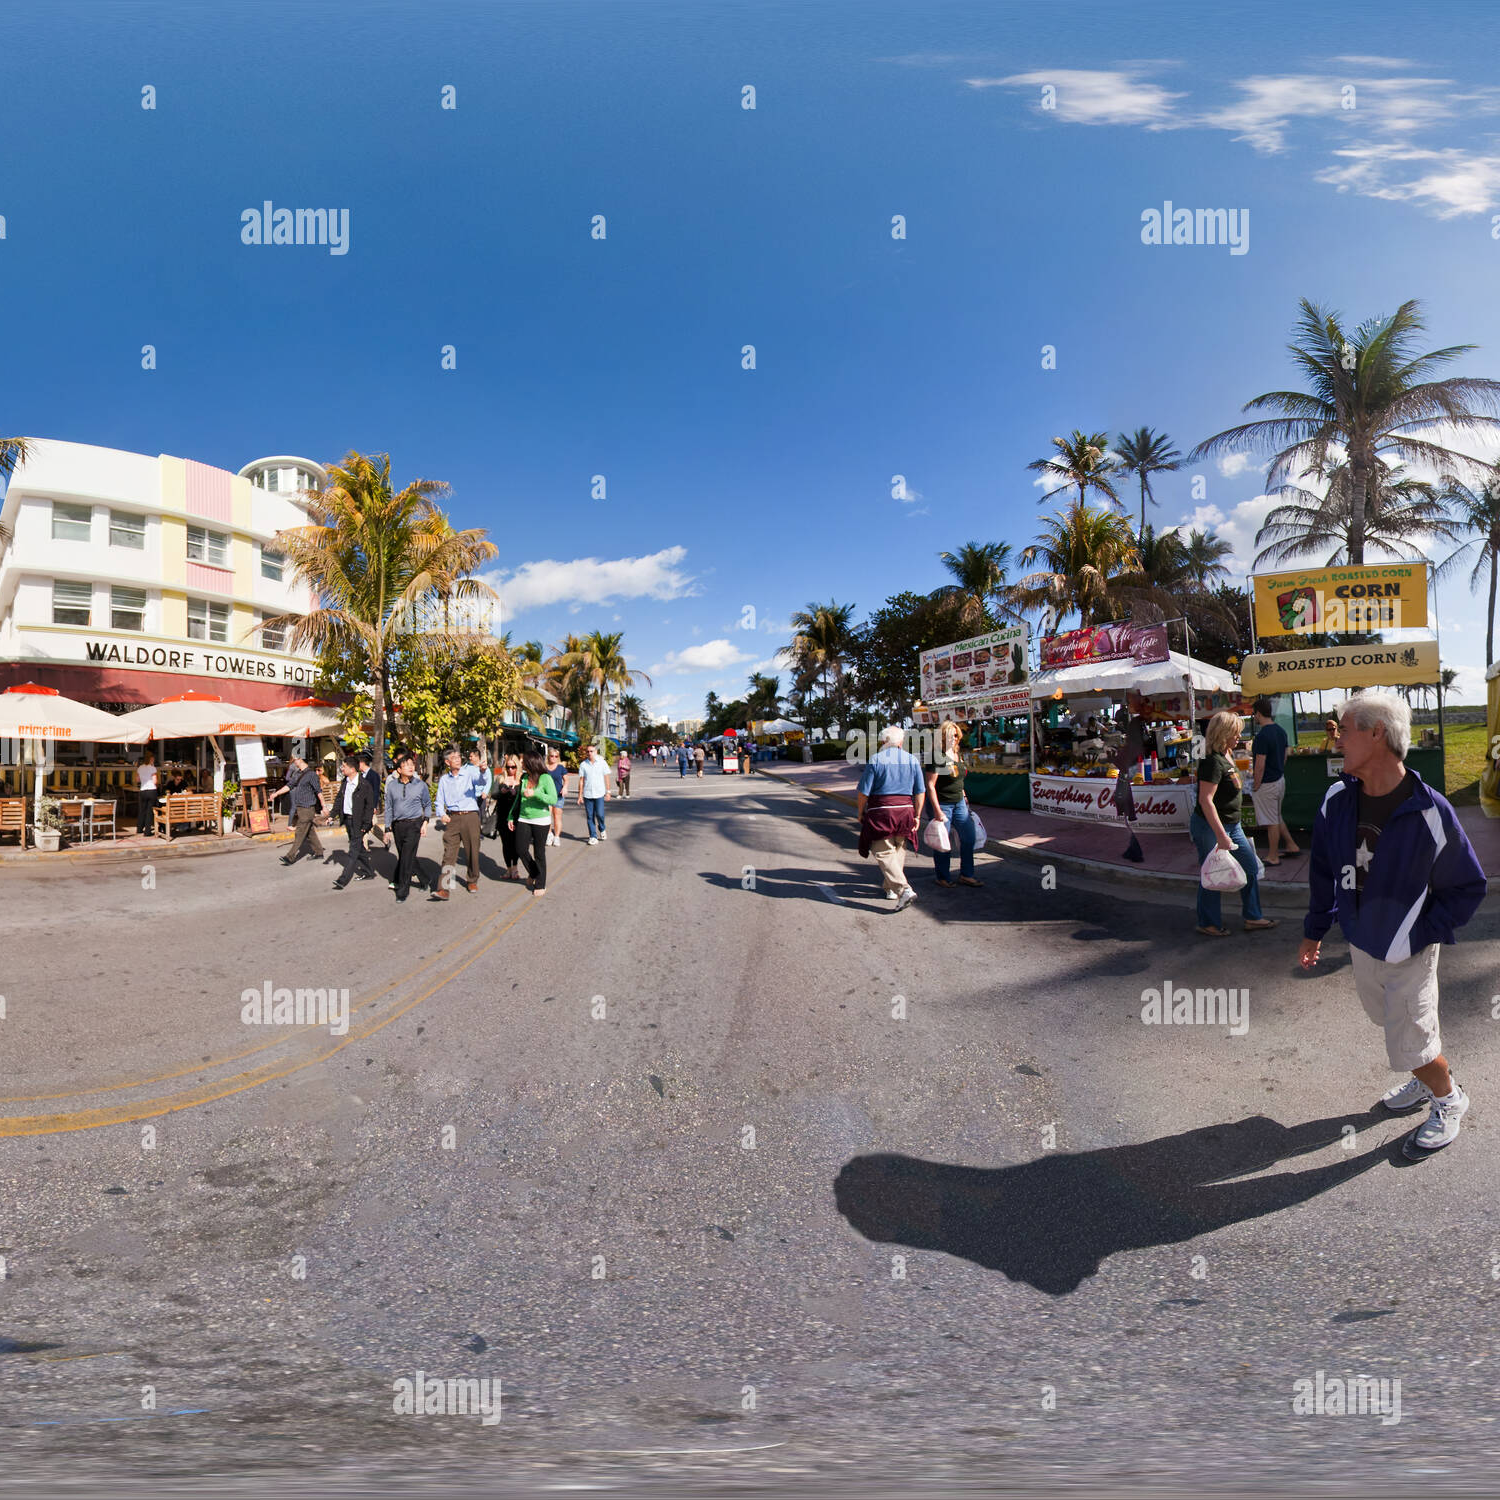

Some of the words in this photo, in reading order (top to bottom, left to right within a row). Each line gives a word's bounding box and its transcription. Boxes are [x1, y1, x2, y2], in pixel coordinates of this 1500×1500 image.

[1331, 568, 1379, 582] ROASTED
[1381, 567, 1412, 578] CORN
[1335, 583, 1400, 598] CORN
[1368, 597, 1387, 606] the
[1347, 606, 1394, 622] COB
[954, 637, 989, 653] Mexican
[990, 628, 1021, 644] Cucina
[1044, 638, 1090, 656] Everything
[86, 642, 194, 669] WALDORF
[203, 655, 276, 678] TOWERS
[284, 665, 322, 684] HOTE
[1277, 656, 1346, 672] ROASTED
[1351, 652, 1397, 666] CORN
[993, 700, 1029, 711] QUESADILLA
[18, 725, 72, 737] primetime
[219, 722, 256, 734] primetime
[1032, 780, 1093, 810] Everything
[1097, 785, 1177, 815] Chcolate
